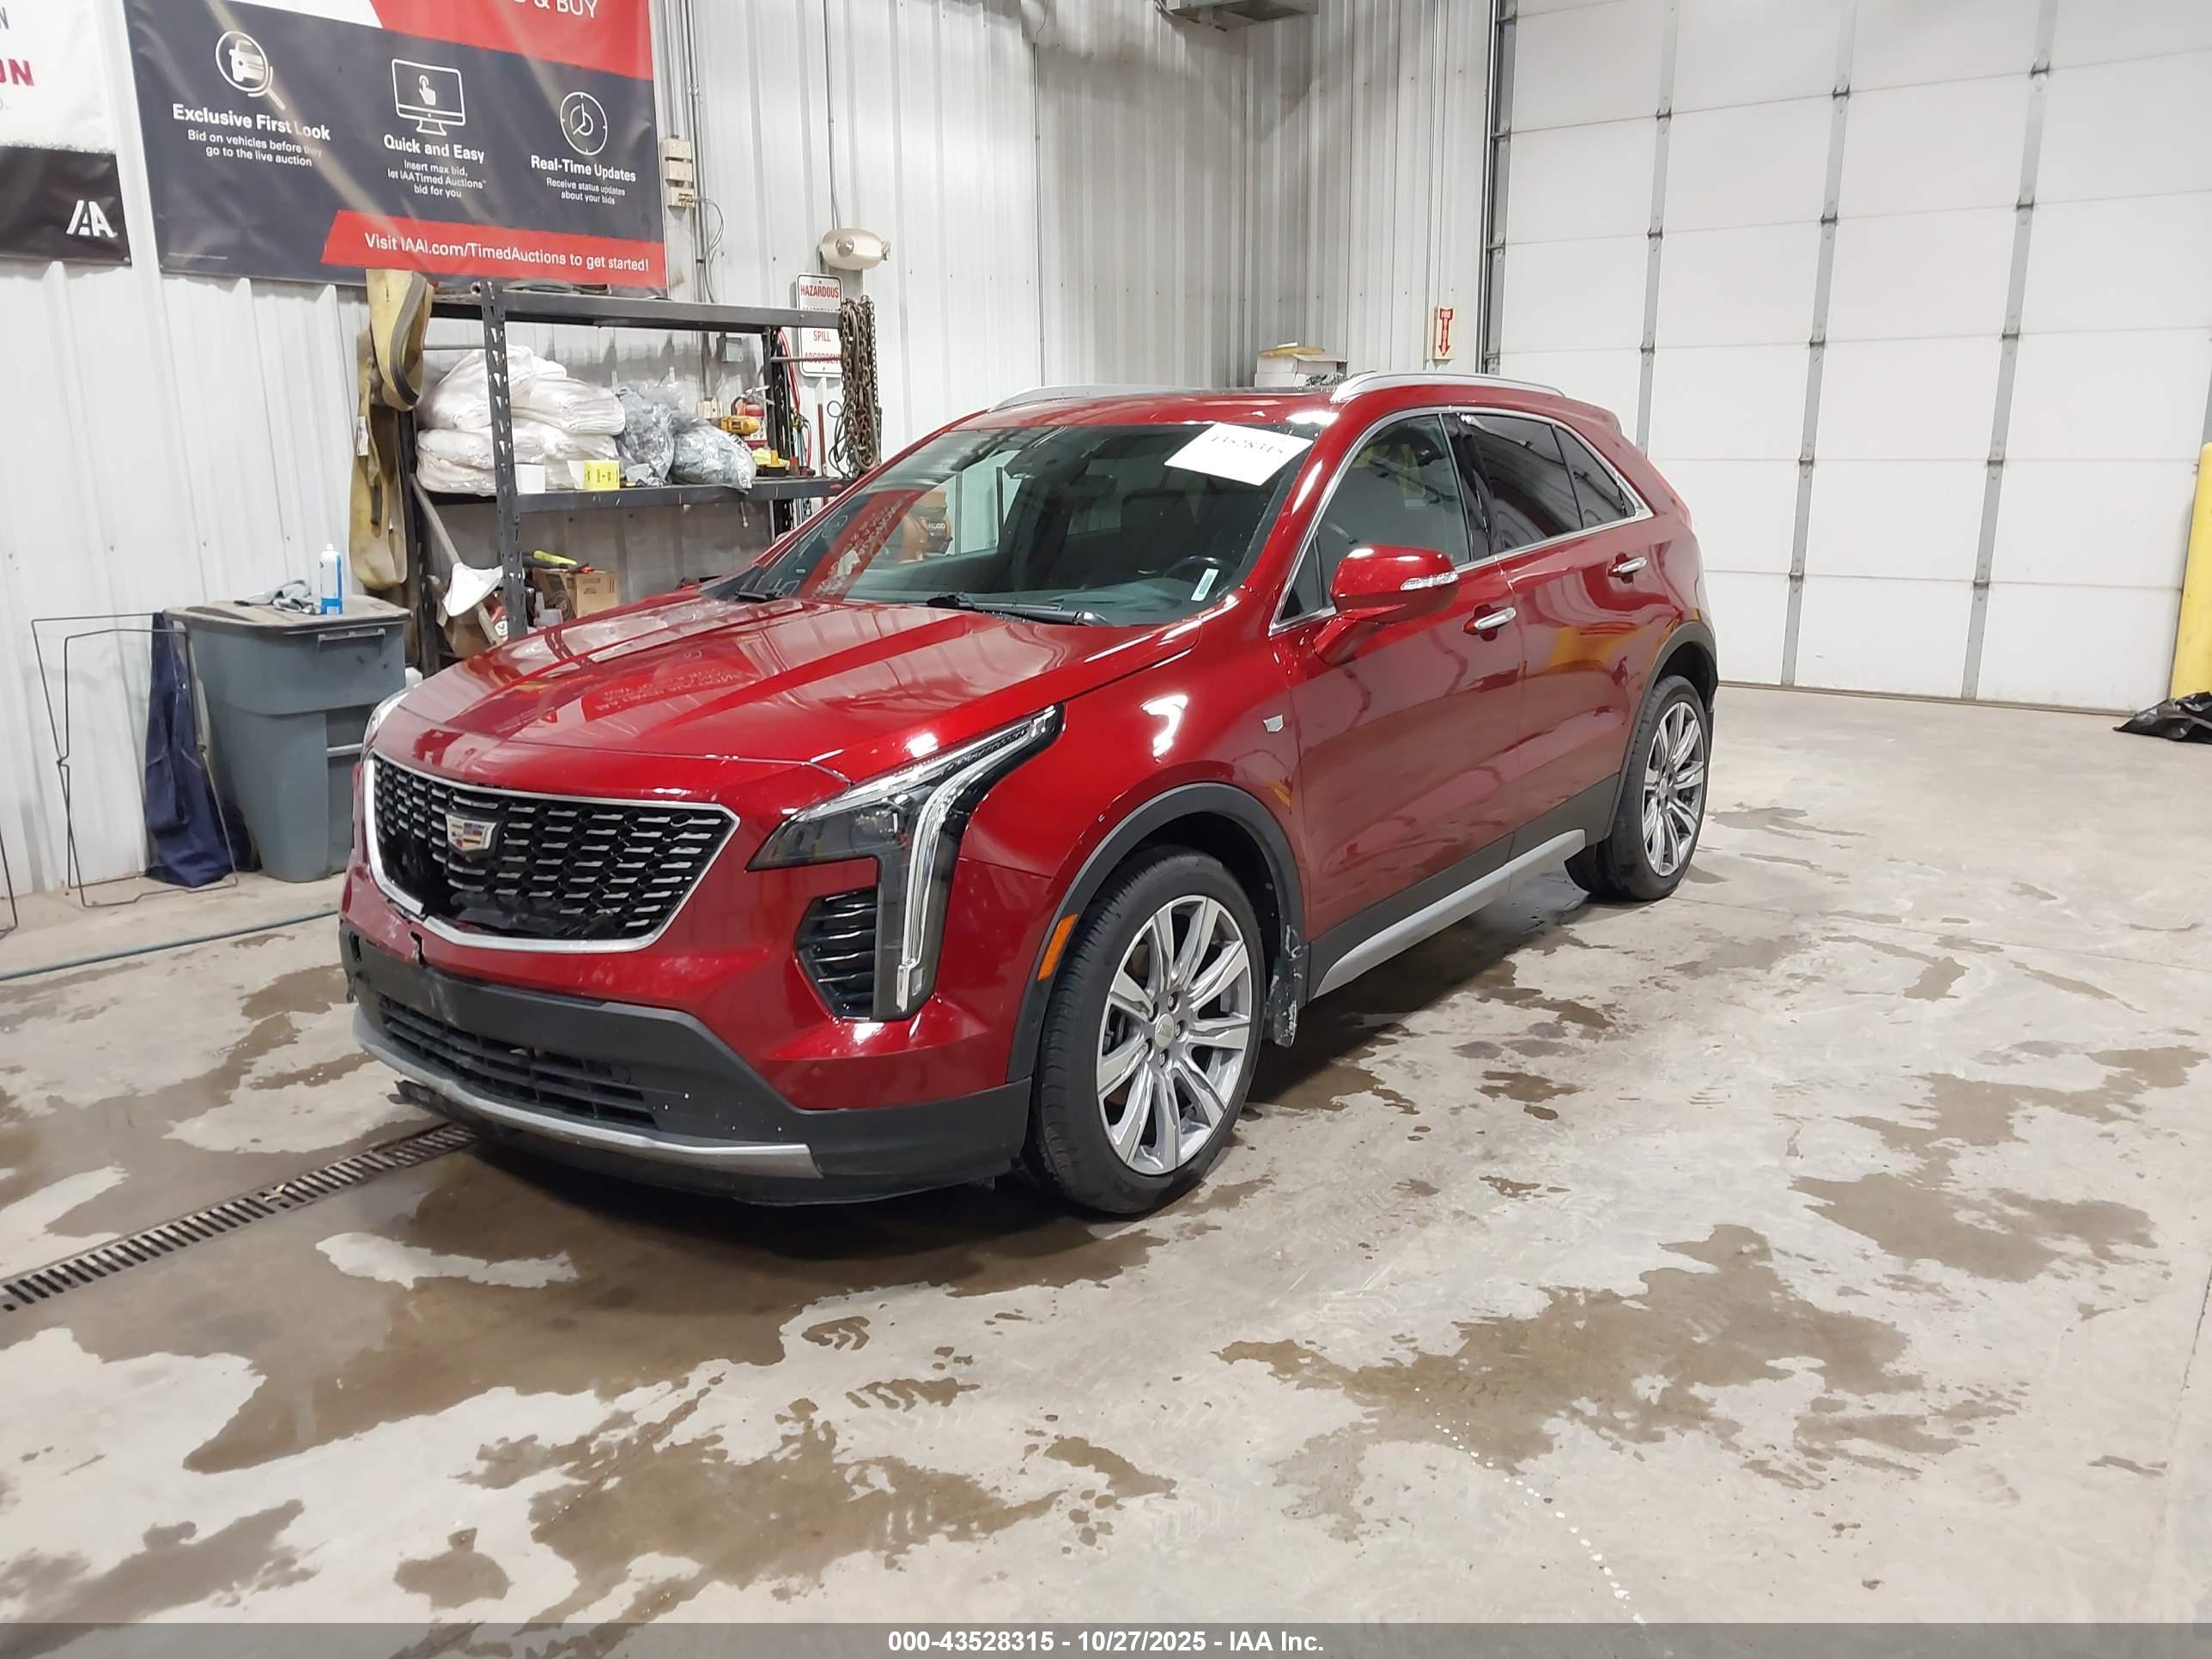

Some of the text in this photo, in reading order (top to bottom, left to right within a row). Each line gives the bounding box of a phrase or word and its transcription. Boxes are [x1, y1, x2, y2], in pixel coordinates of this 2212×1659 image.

[172, 103, 331, 141] Exclusive First Look
[187, 130, 323, 157] Bid on vehicles before thy
[383, 134, 485, 164] Quick and Easy
[205, 146, 313, 167] go to the live auction
[387, 167, 398, 179] let
[404, 159, 468, 177] Insert max bid,
[531, 155, 637, 182] Real-Time Updates
[414, 184, 462, 199] bid for you
[546, 177, 626, 197] Receive status updates
[561, 191, 616, 205] about your bids
[364, 232, 649, 271] Visit IAAI.com/TimedAuctions to get started!
[800, 284, 839, 298] HAZARDOUS
[813, 331, 831, 343] SPILL
